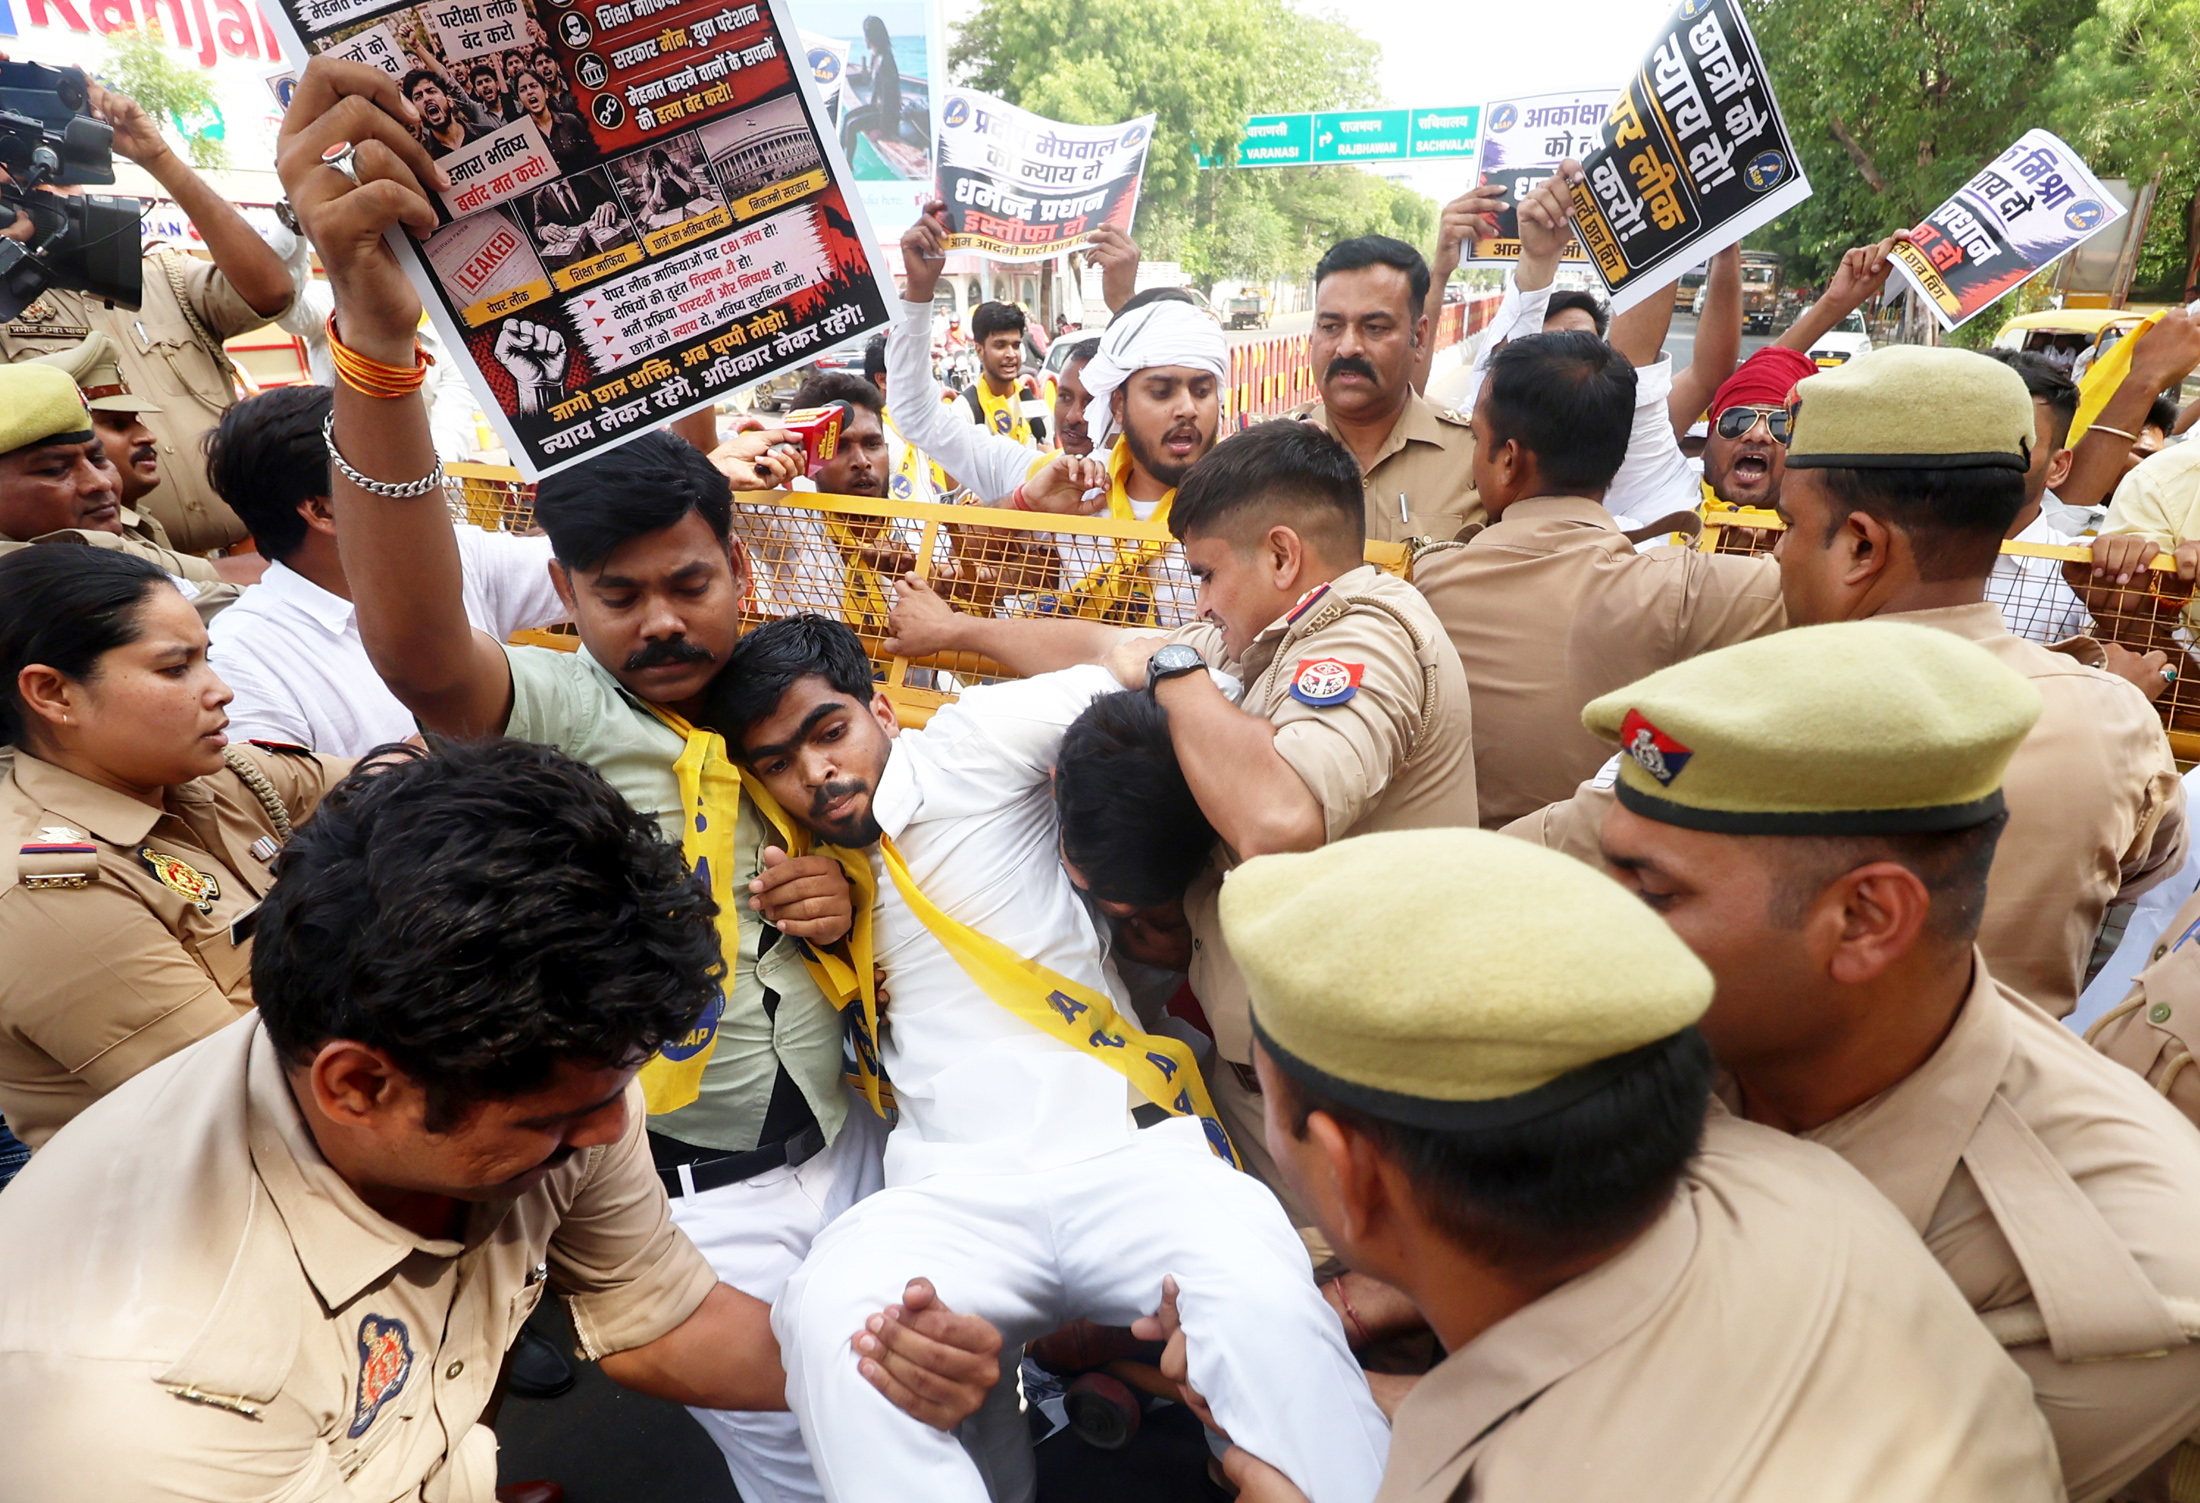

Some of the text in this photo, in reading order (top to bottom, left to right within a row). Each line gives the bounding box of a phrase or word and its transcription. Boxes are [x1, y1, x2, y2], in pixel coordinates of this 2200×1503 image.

[437, 5, 482, 28] परीक्षा
[596, 4, 633, 30] शिक्षा
[365, 35, 388, 56] को
[458, 21, 515, 50] बंद करो
[610, 41, 659, 70] सरकार
[690, 18, 717, 47] युवा
[714, 3, 760, 33] परेशान
[382, 56, 400, 74] दो
[625, 38, 778, 109] मेहनत करने वालों के सपनों
[1688, 10, 1769, 148] छात्रों को
[635, 83, 734, 132] की हत्या बंद करो!
[1417, 114, 1469, 130] सचिवालय
[1523, 98, 1609, 129] आकांक्षा
[1652, 31, 1737, 195] न्याय दो!
[1247, 121, 1289, 138] वाराणसी
[1339, 119, 1383, 134] राजभवन
[485, 133, 529, 166] भविष्य
[1035, 130, 1120, 160] मेघवाल
[1246, 146, 1299, 160] VARANASI
[1337, 142, 1397, 156] RAJBHAWAN
[1544, 130, 1574, 157] को
[453, 156, 549, 212] बर्बाद मत करो!
[1021, 158, 1078, 183] न्याय
[1082, 158, 1104, 180] दो
[1748, 164, 1764, 186] ASAP
[2011, 148, 2076, 211] मिश्रा
[781, 178, 811, 201] सरकार
[1592, 155, 1648, 243] करो!
[1628, 144, 1686, 231] लीक
[1971, 170, 2036, 222] याय दो
[1038, 189, 1109, 222] प्रधान
[2066, 211, 2088, 228] ASAP
[963, 210, 1090, 243] इस्तीफा दो
[1932, 201, 2003, 267] प्रधान
[457, 230, 517, 291] LEAKED
[950, 236, 973, 249] आम
[976, 238, 1020, 256] आदमी
[1023, 242, 1049, 255] पार्टी
[1584, 219, 1606, 247] छात्र
[1597, 241, 1619, 271] विंग
[1929, 239, 1965, 272] दो
[569, 252, 628, 283] शिक्षा माफिया
[602, 222, 779, 303] पेपर लीक माफियाओं पर CBI जांच हो!
[1904, 252, 1930, 276] छात्र
[1922, 272, 1948, 301] विंग
[486, 289, 530, 314] पेपर लीक
[610, 254, 753, 320] दोषियों की तुरंत गिरफ्तरी हो!
[620, 317, 644, 339] भर्ती
[676, 289, 717, 317] पारदर्शी
[716, 281, 737, 302] और
[736, 267, 772, 293] निष्पक्ष
[771, 261, 789, 278] हो!
[628, 334, 656, 356] छात्रों
[654, 327, 671, 345] को
[670, 318, 699, 338] न्याय
[715, 296, 747, 325] भविष्य
[746, 283, 784, 311] सुरक्षित
[783, 273, 807, 293] करो!
[537, 304, 866, 456] न्याय लेकर रहेंगे, अधिकार लेकर रहेंगे!
[547, 387, 590, 423] जागो
[590, 377, 629, 405] छात्र
[625, 355, 680, 394] शक्ति,
[679, 348, 710, 371] अब
[745, 309, 790, 341] तोड़ो!
